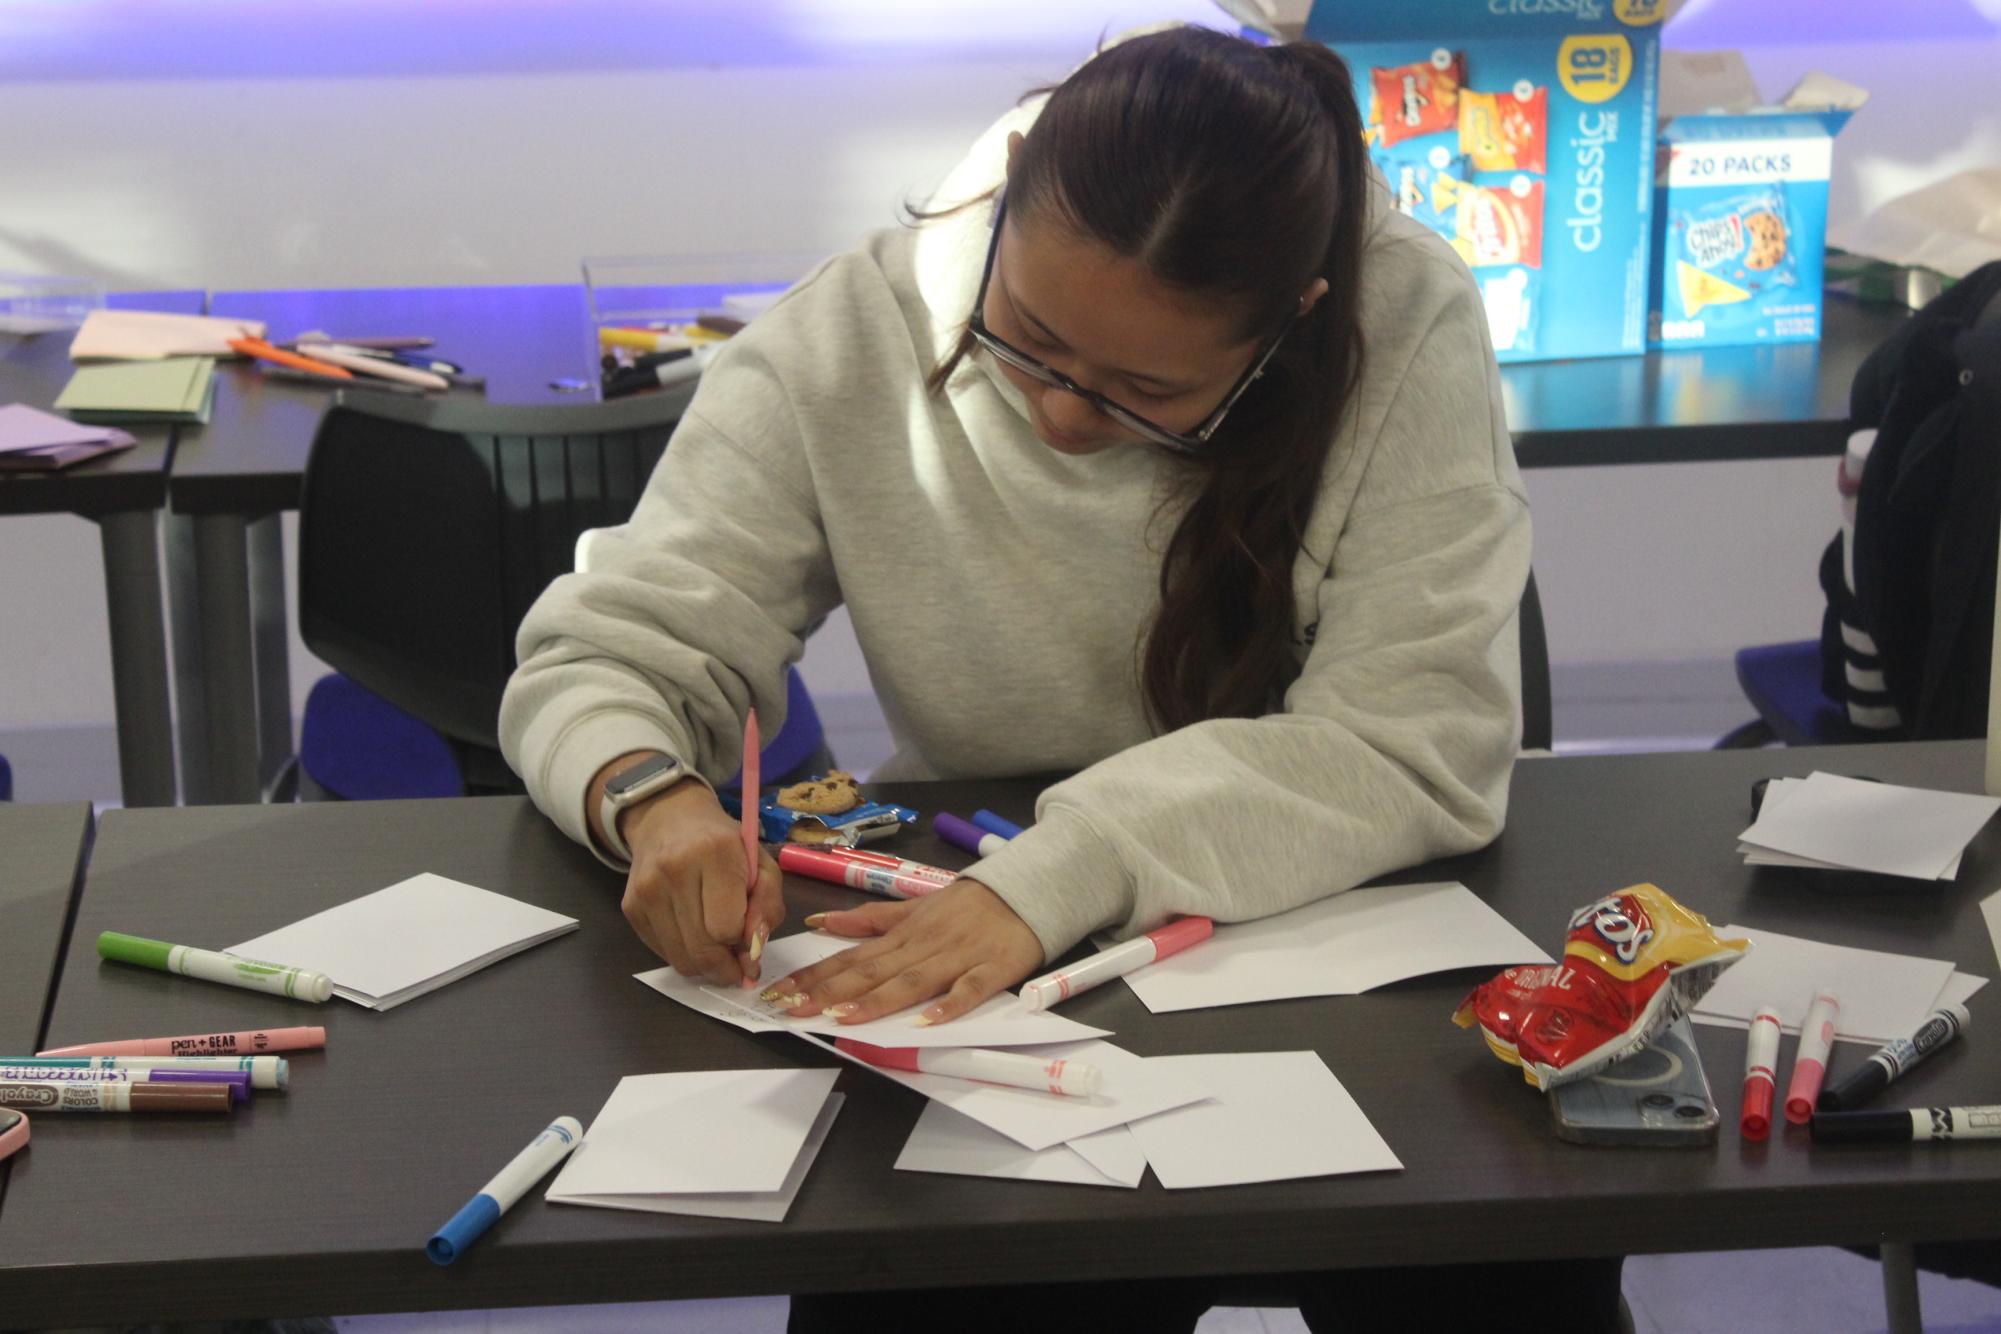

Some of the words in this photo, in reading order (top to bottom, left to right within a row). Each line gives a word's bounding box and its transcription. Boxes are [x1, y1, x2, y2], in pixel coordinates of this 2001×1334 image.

[1571, 47, 1606, 86] 18
[1689, 158, 1715, 177] 20
[1724, 153, 1792, 174] PACKS
[1566, 110, 1605, 253] classic
[171, 1038, 197, 1055] pen
[208, 1034, 236, 1048] GEAR
[0, 1086, 52, 1104] Crayol
[62, 1096, 99, 1106] COLORS
